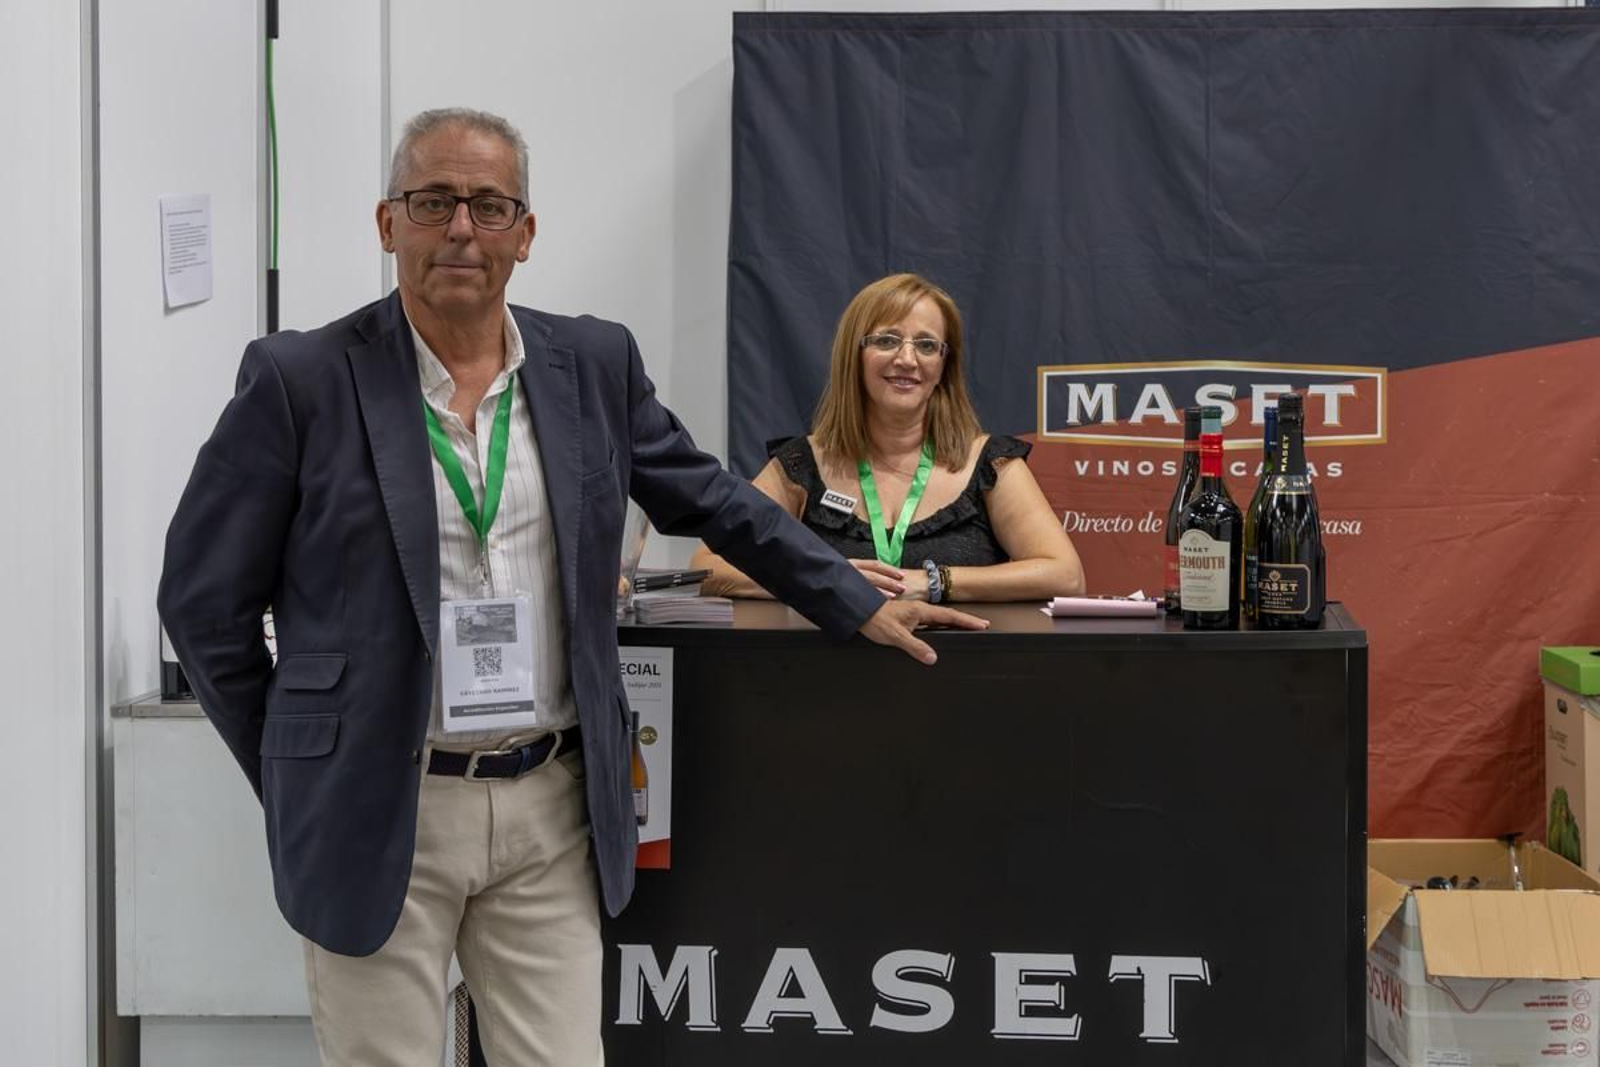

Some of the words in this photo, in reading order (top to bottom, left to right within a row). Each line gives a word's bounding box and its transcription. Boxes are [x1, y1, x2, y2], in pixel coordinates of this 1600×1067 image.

[1281, 435, 1289, 472] MASET
[1075, 460, 1177, 476] VINOS
[1230, 461, 1343, 477] CAS
[1063, 511, 1133, 533] Directo
[1138, 511, 1163, 533] de
[615, 943, 1212, 1043] MASET
